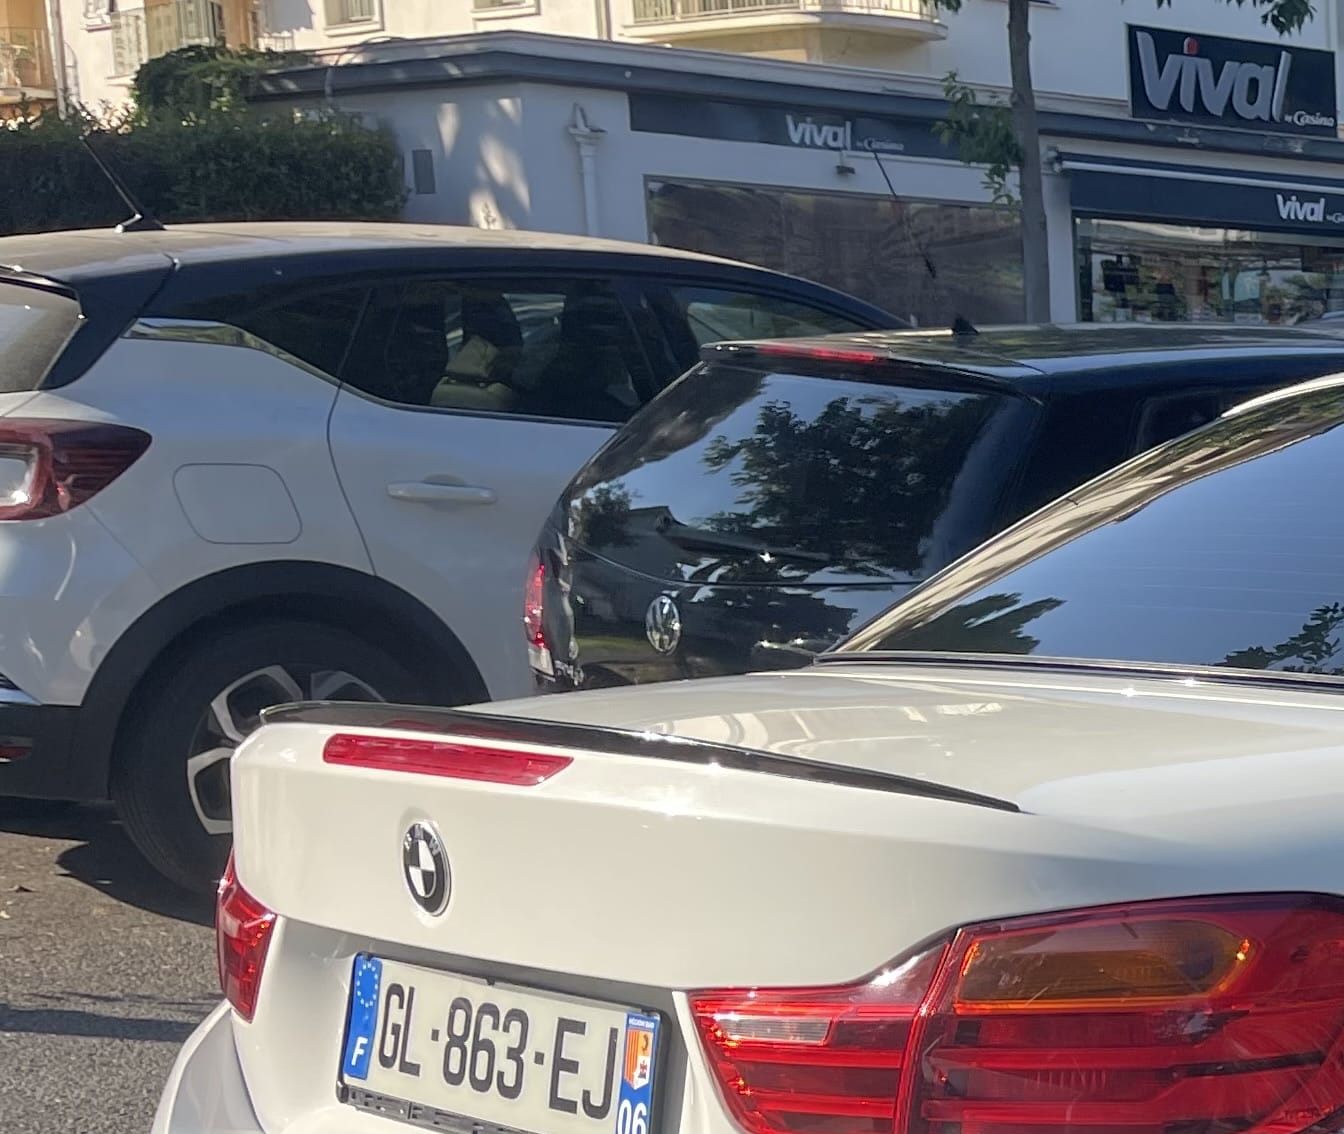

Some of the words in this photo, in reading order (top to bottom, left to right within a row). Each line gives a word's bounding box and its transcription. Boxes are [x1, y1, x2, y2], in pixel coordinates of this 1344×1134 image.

[1136, 31, 1292, 122] Vival
[1293, 110, 1335, 127] Casino
[785, 114, 852, 151] Vival
[1276, 194, 1325, 222] Vival
[403, 823, 442, 857] BMW
[351, 1036, 369, 1067] F
